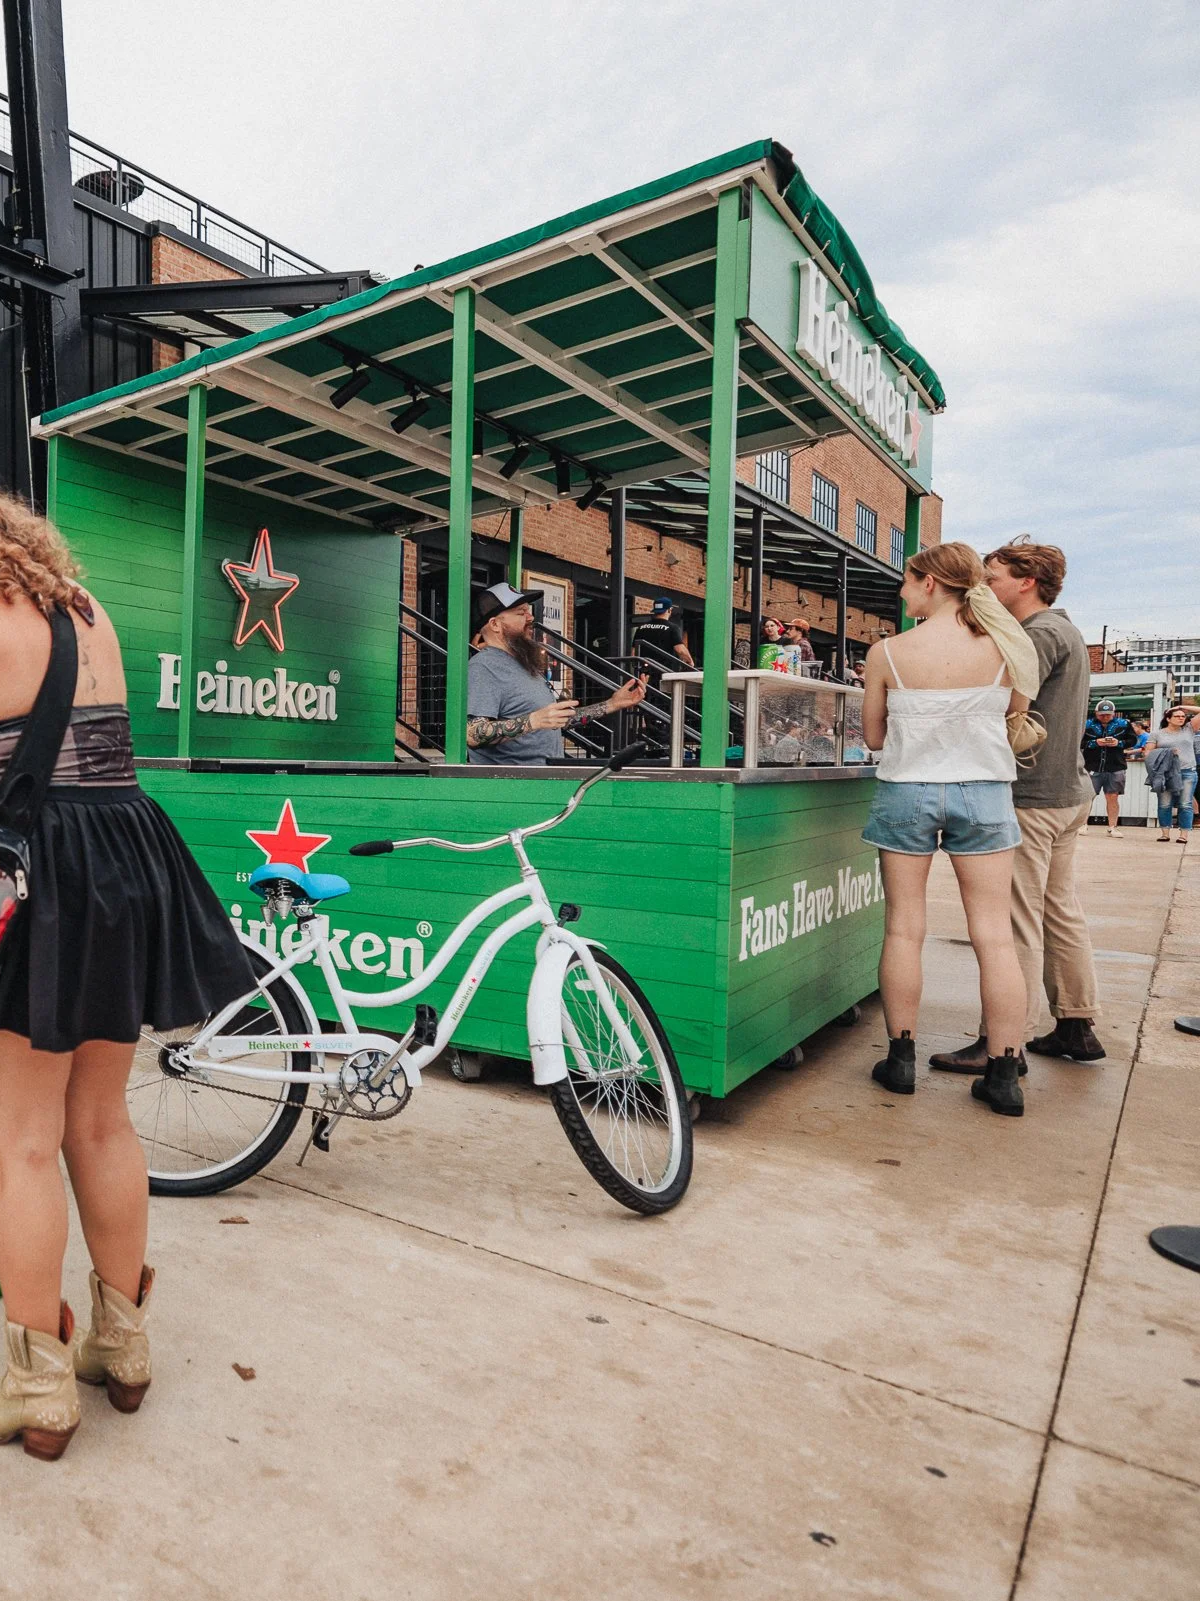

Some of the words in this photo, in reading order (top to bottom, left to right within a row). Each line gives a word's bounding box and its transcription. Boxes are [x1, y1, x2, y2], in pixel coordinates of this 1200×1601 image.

[738, 896, 788, 962] Fans
[792, 880, 834, 939] Have
[836, 866, 872, 920] More
[248, 1041, 299, 1050] Heineken
